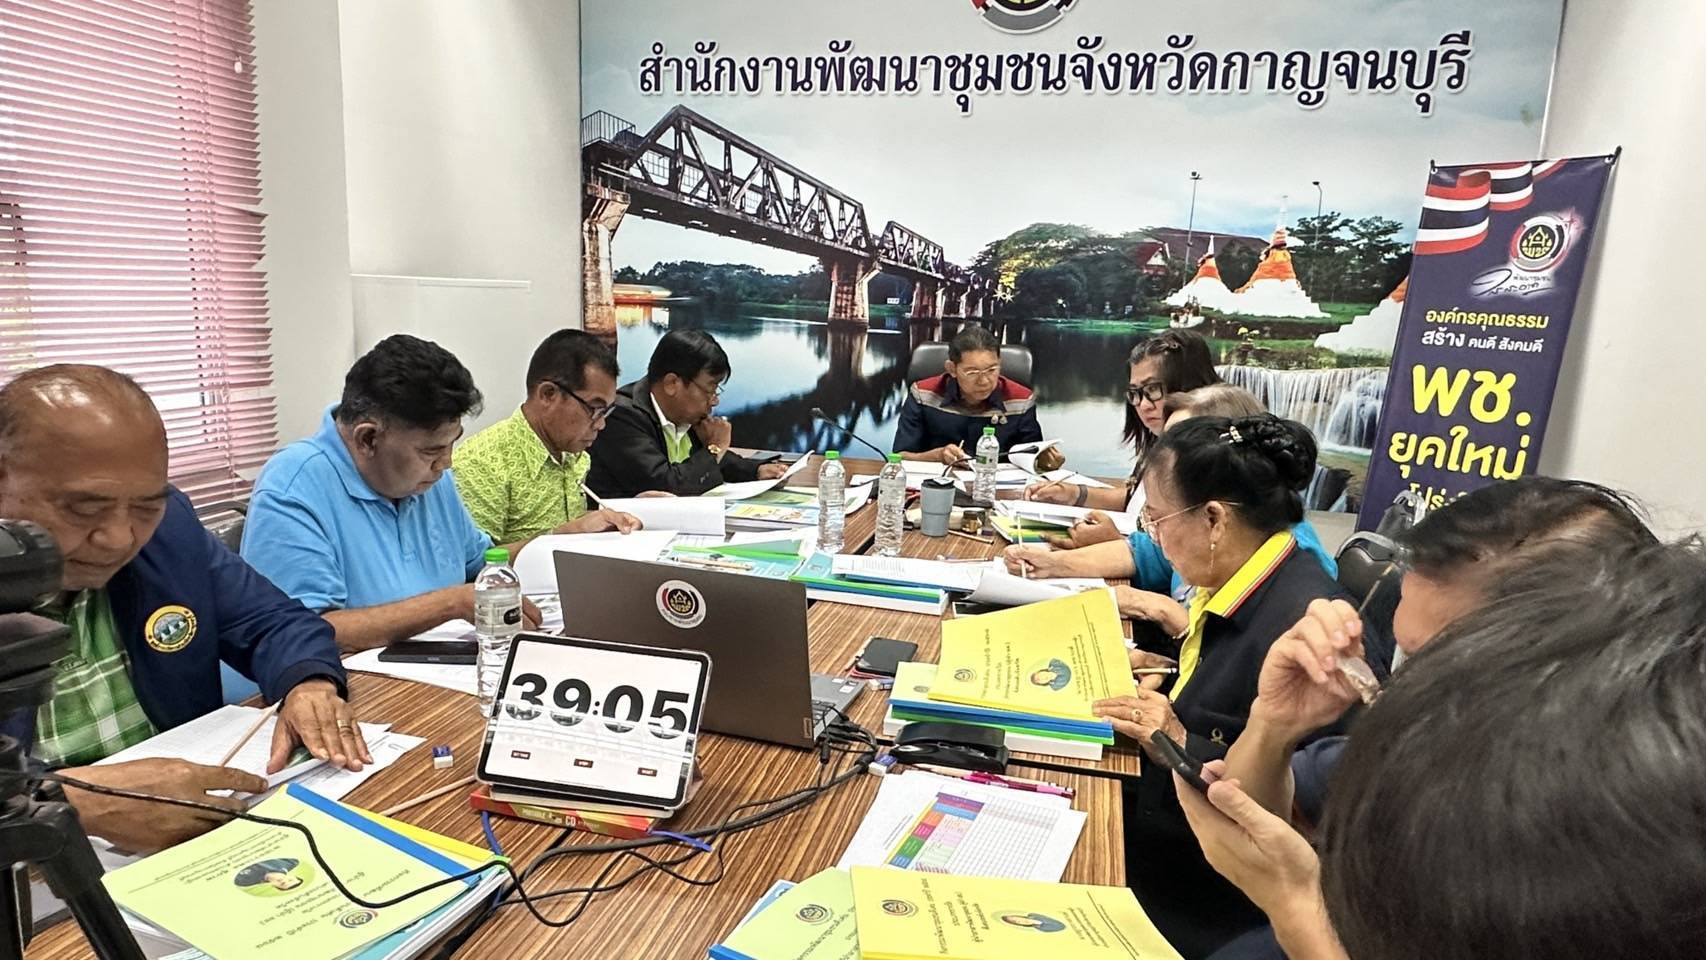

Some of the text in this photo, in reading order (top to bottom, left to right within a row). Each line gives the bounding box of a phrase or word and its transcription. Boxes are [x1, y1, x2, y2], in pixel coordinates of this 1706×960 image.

[639, 30, 1472, 113] สำนักงานพัฒนาชุมชนจังหวัดกาญจนบุรี
[1421, 327, 1544, 352] สร้าง คนดี สังคมดี
[1425, 307, 1549, 331] องค์กรคุณธรรม
[1412, 364, 1531, 426] พช.
[1388, 425, 1530, 480] ยุคใหม่
[505, 672, 691, 740] 39:05
